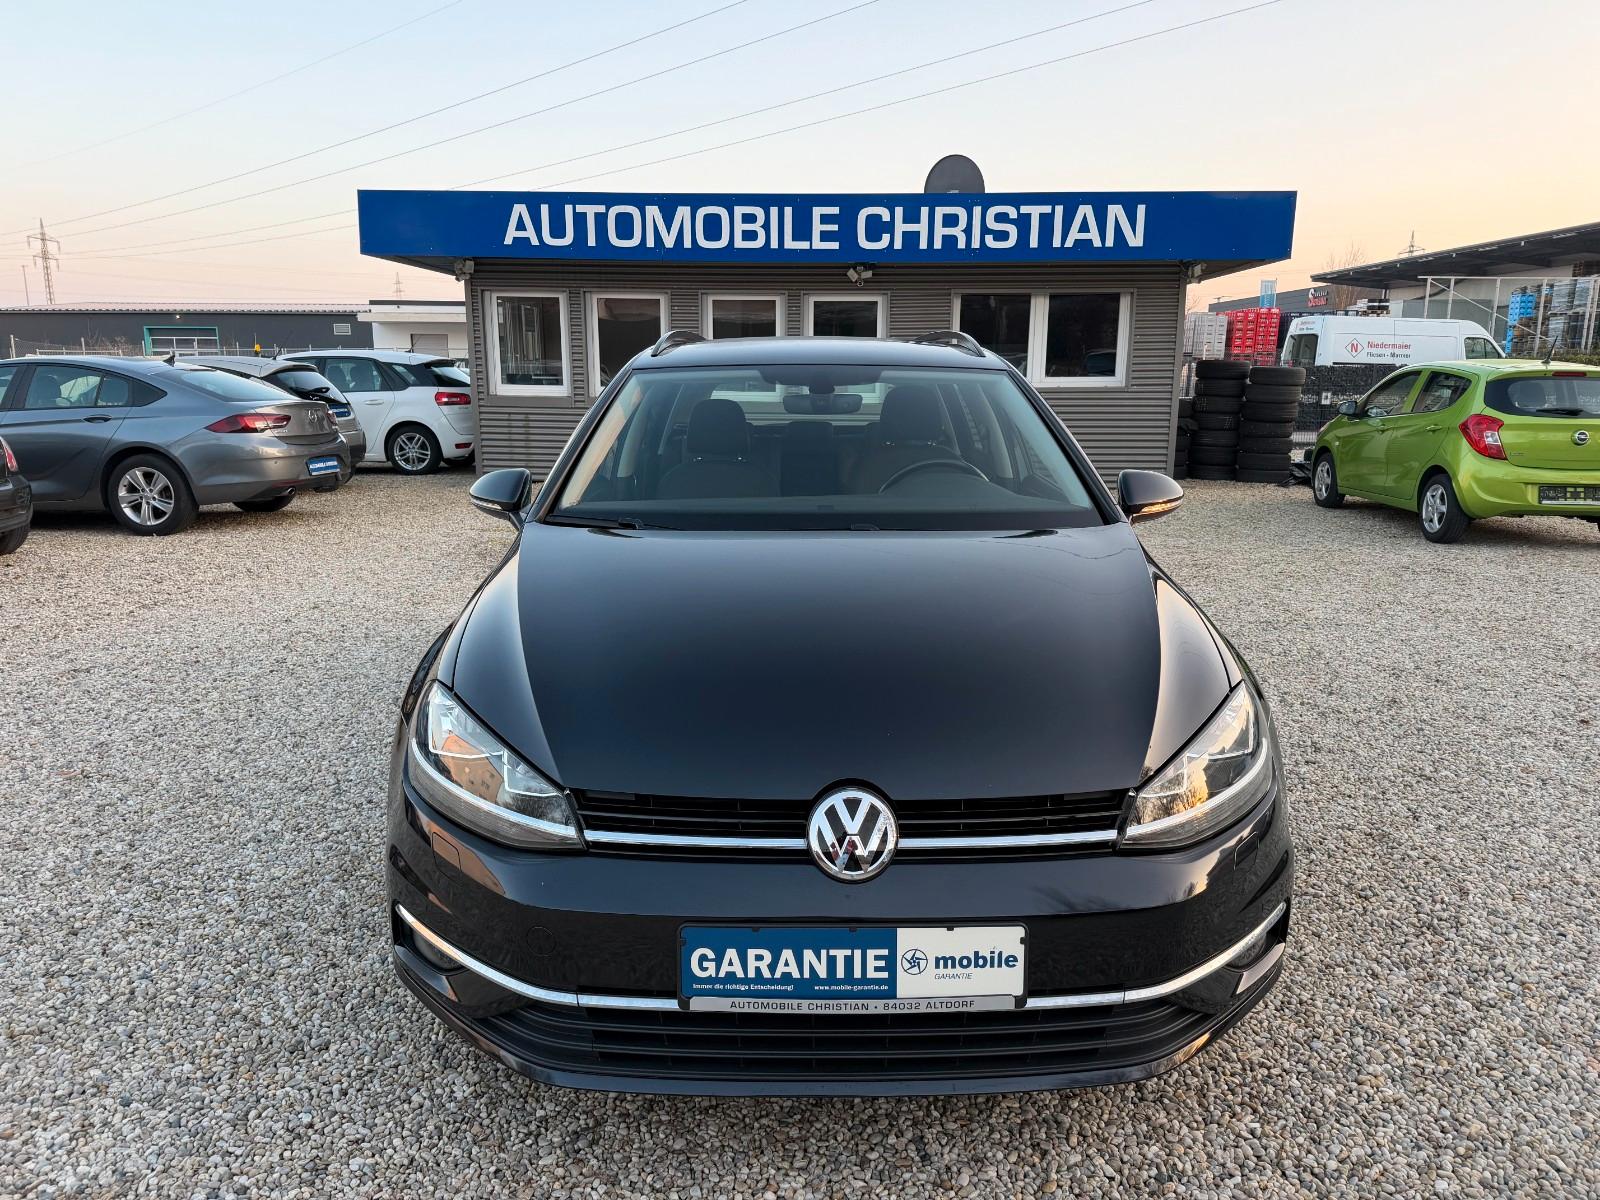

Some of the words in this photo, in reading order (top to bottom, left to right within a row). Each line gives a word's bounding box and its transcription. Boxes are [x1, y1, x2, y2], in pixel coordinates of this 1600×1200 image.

[503, 203, 840, 250] AUTOMOBILE
[857, 203, 1147, 250] CHRISTIAN
[1350, 342, 1359, 353] N
[1367, 340, 1412, 350] Niedermaier
[690, 947, 889, 979] GARANTIE
[934, 949, 1019, 970] mobile
[934, 972, 973, 980] GARANTIE
[725, 983, 749, 992] richtige
[750, 983, 795, 992] Entscheidung!
[814, 984, 889, 992] www.mobile-garantie.de
[730, 1000, 803, 1011] AUTOMOBILE
[807, 1001, 869, 1012] CHRISTIAN
[883, 1002, 921, 1011] 84032
[925, 1000, 976, 1010] ALTDORF
